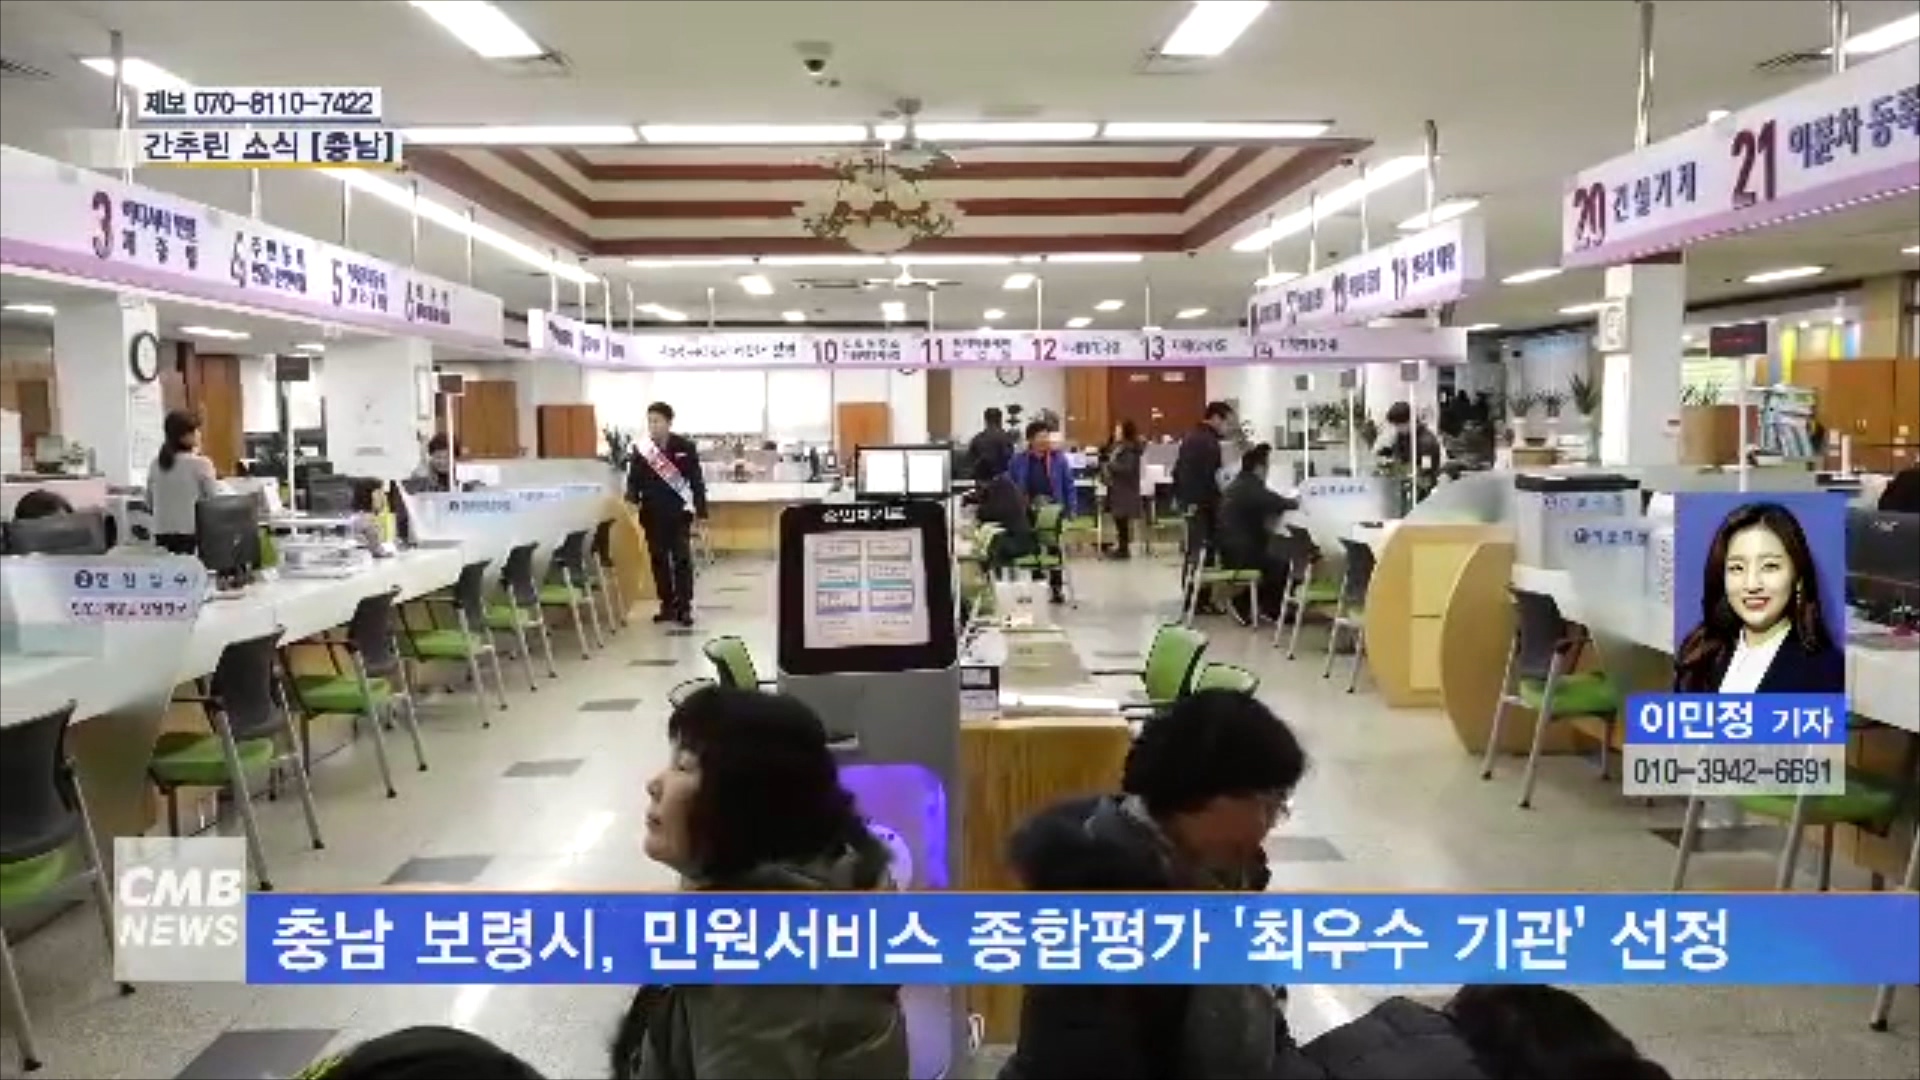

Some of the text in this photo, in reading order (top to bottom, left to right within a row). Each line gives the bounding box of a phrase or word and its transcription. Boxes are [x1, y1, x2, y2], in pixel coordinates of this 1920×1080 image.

[1574, 182, 1605, 249] 20
[1731, 119, 1777, 209] 21
[92, 191, 114, 259] 3
[332, 258, 343, 307] 5
[813, 339, 838, 363] 10
[921, 339, 945, 363] 11
[1031, 338, 1057, 361] 12
[1140, 336, 1166, 361] 13
